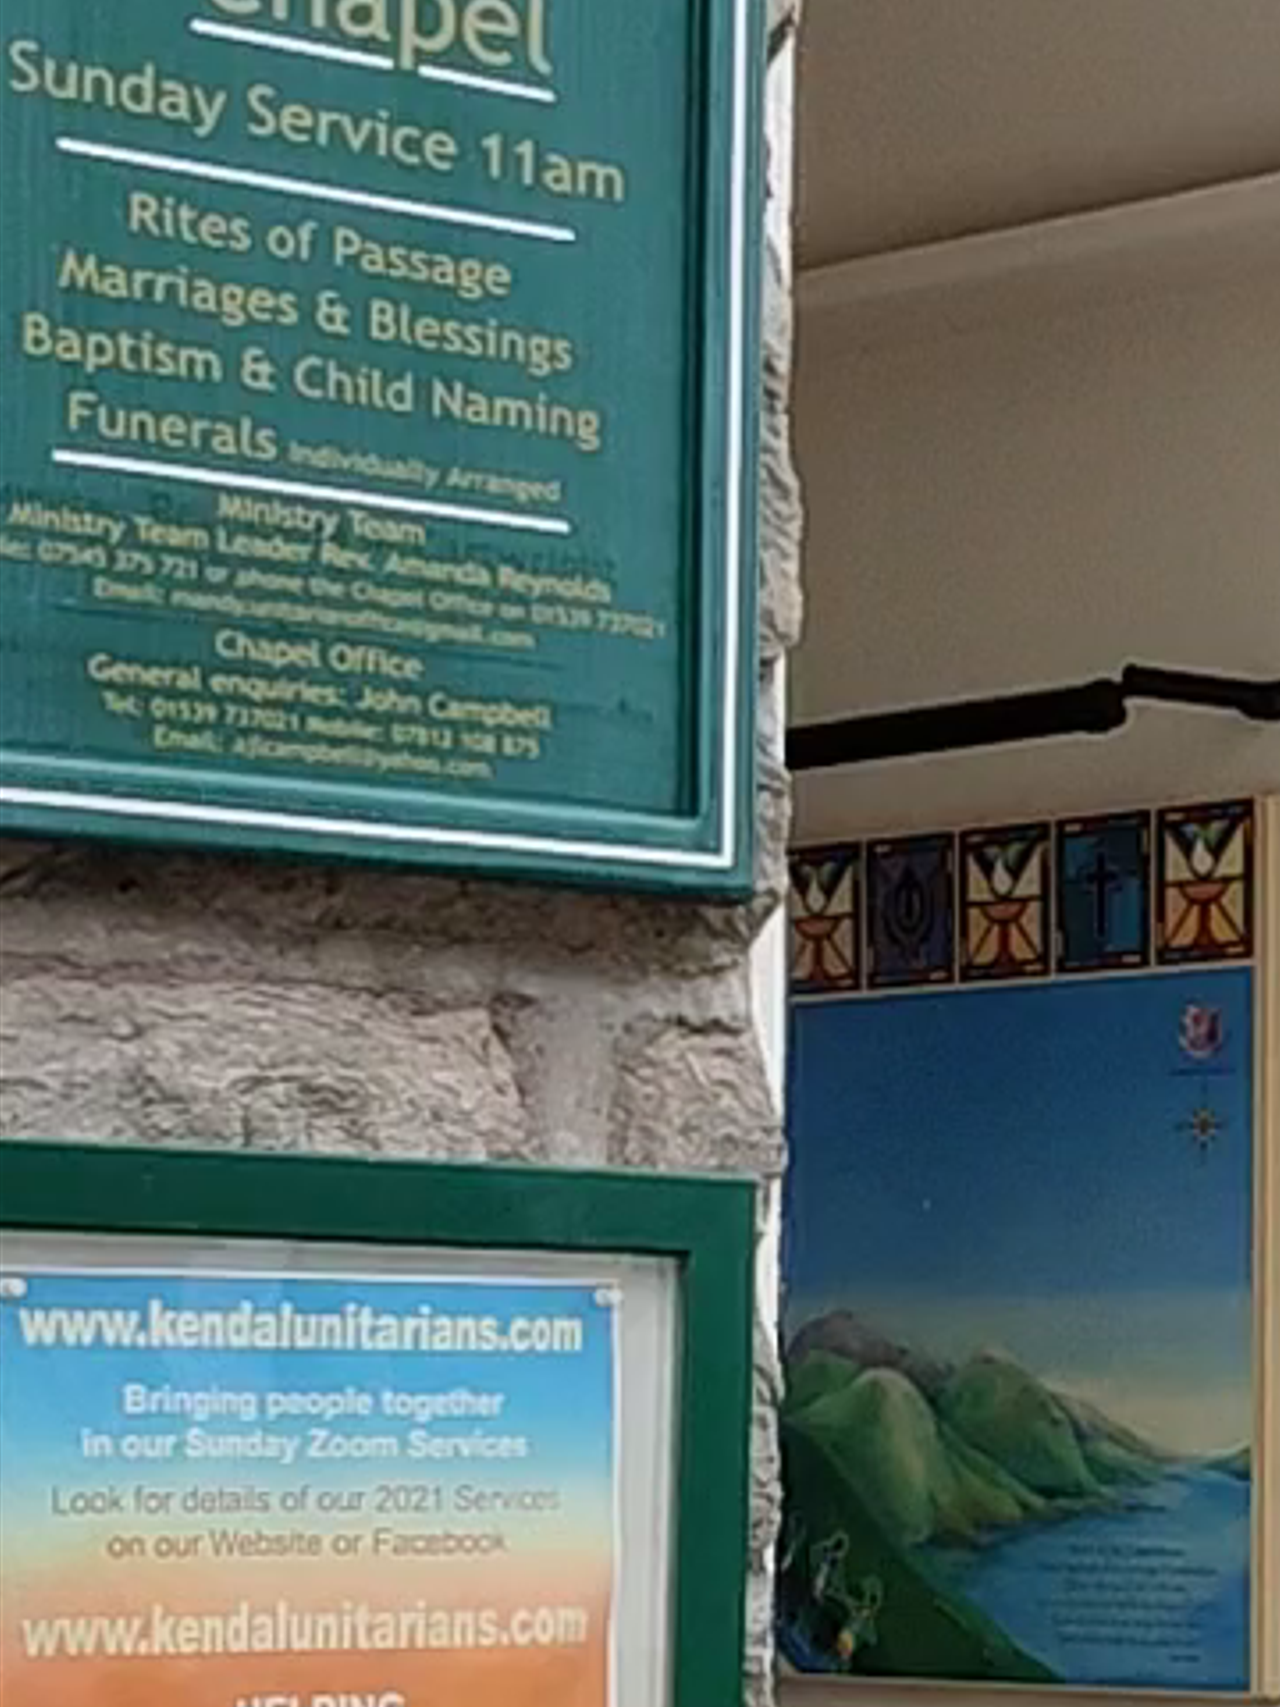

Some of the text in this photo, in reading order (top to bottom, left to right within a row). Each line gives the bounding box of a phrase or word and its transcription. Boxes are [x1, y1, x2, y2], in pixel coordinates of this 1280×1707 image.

[10, 41, 625, 203] Sunday Service 11am
[129, 191, 512, 299] Rites of Passage
[59, 248, 573, 376] Marriages & Blessings
[22, 312, 600, 452] Baptism & Child Naming
[68, 391, 278, 461] Funerals
[447, 467, 561, 502] Arranged
[8, 502, 126, 543] Ministry
[133, 515, 209, 550] Team
[216, 526, 313, 562] Leader
[218, 493, 426, 545] Ministry Team
[215, 628, 426, 680] Chapel Office
[87, 652, 200, 690] General
[356, 687, 422, 715] John
[428, 691, 552, 731] Campbell
[19, 1297, 583, 1351] www.kendalunitarians.com
[123, 1382, 505, 1423] Bringing people together
[80, 1426, 528, 1464] in our Sunday Zoom Services
[51, 1484, 561, 1515] Look for details of our 2021 Services
[107, 1527, 509, 1559] on our Website or Facebook
[22, 1601, 588, 1658] www.kendalunitarians.com
